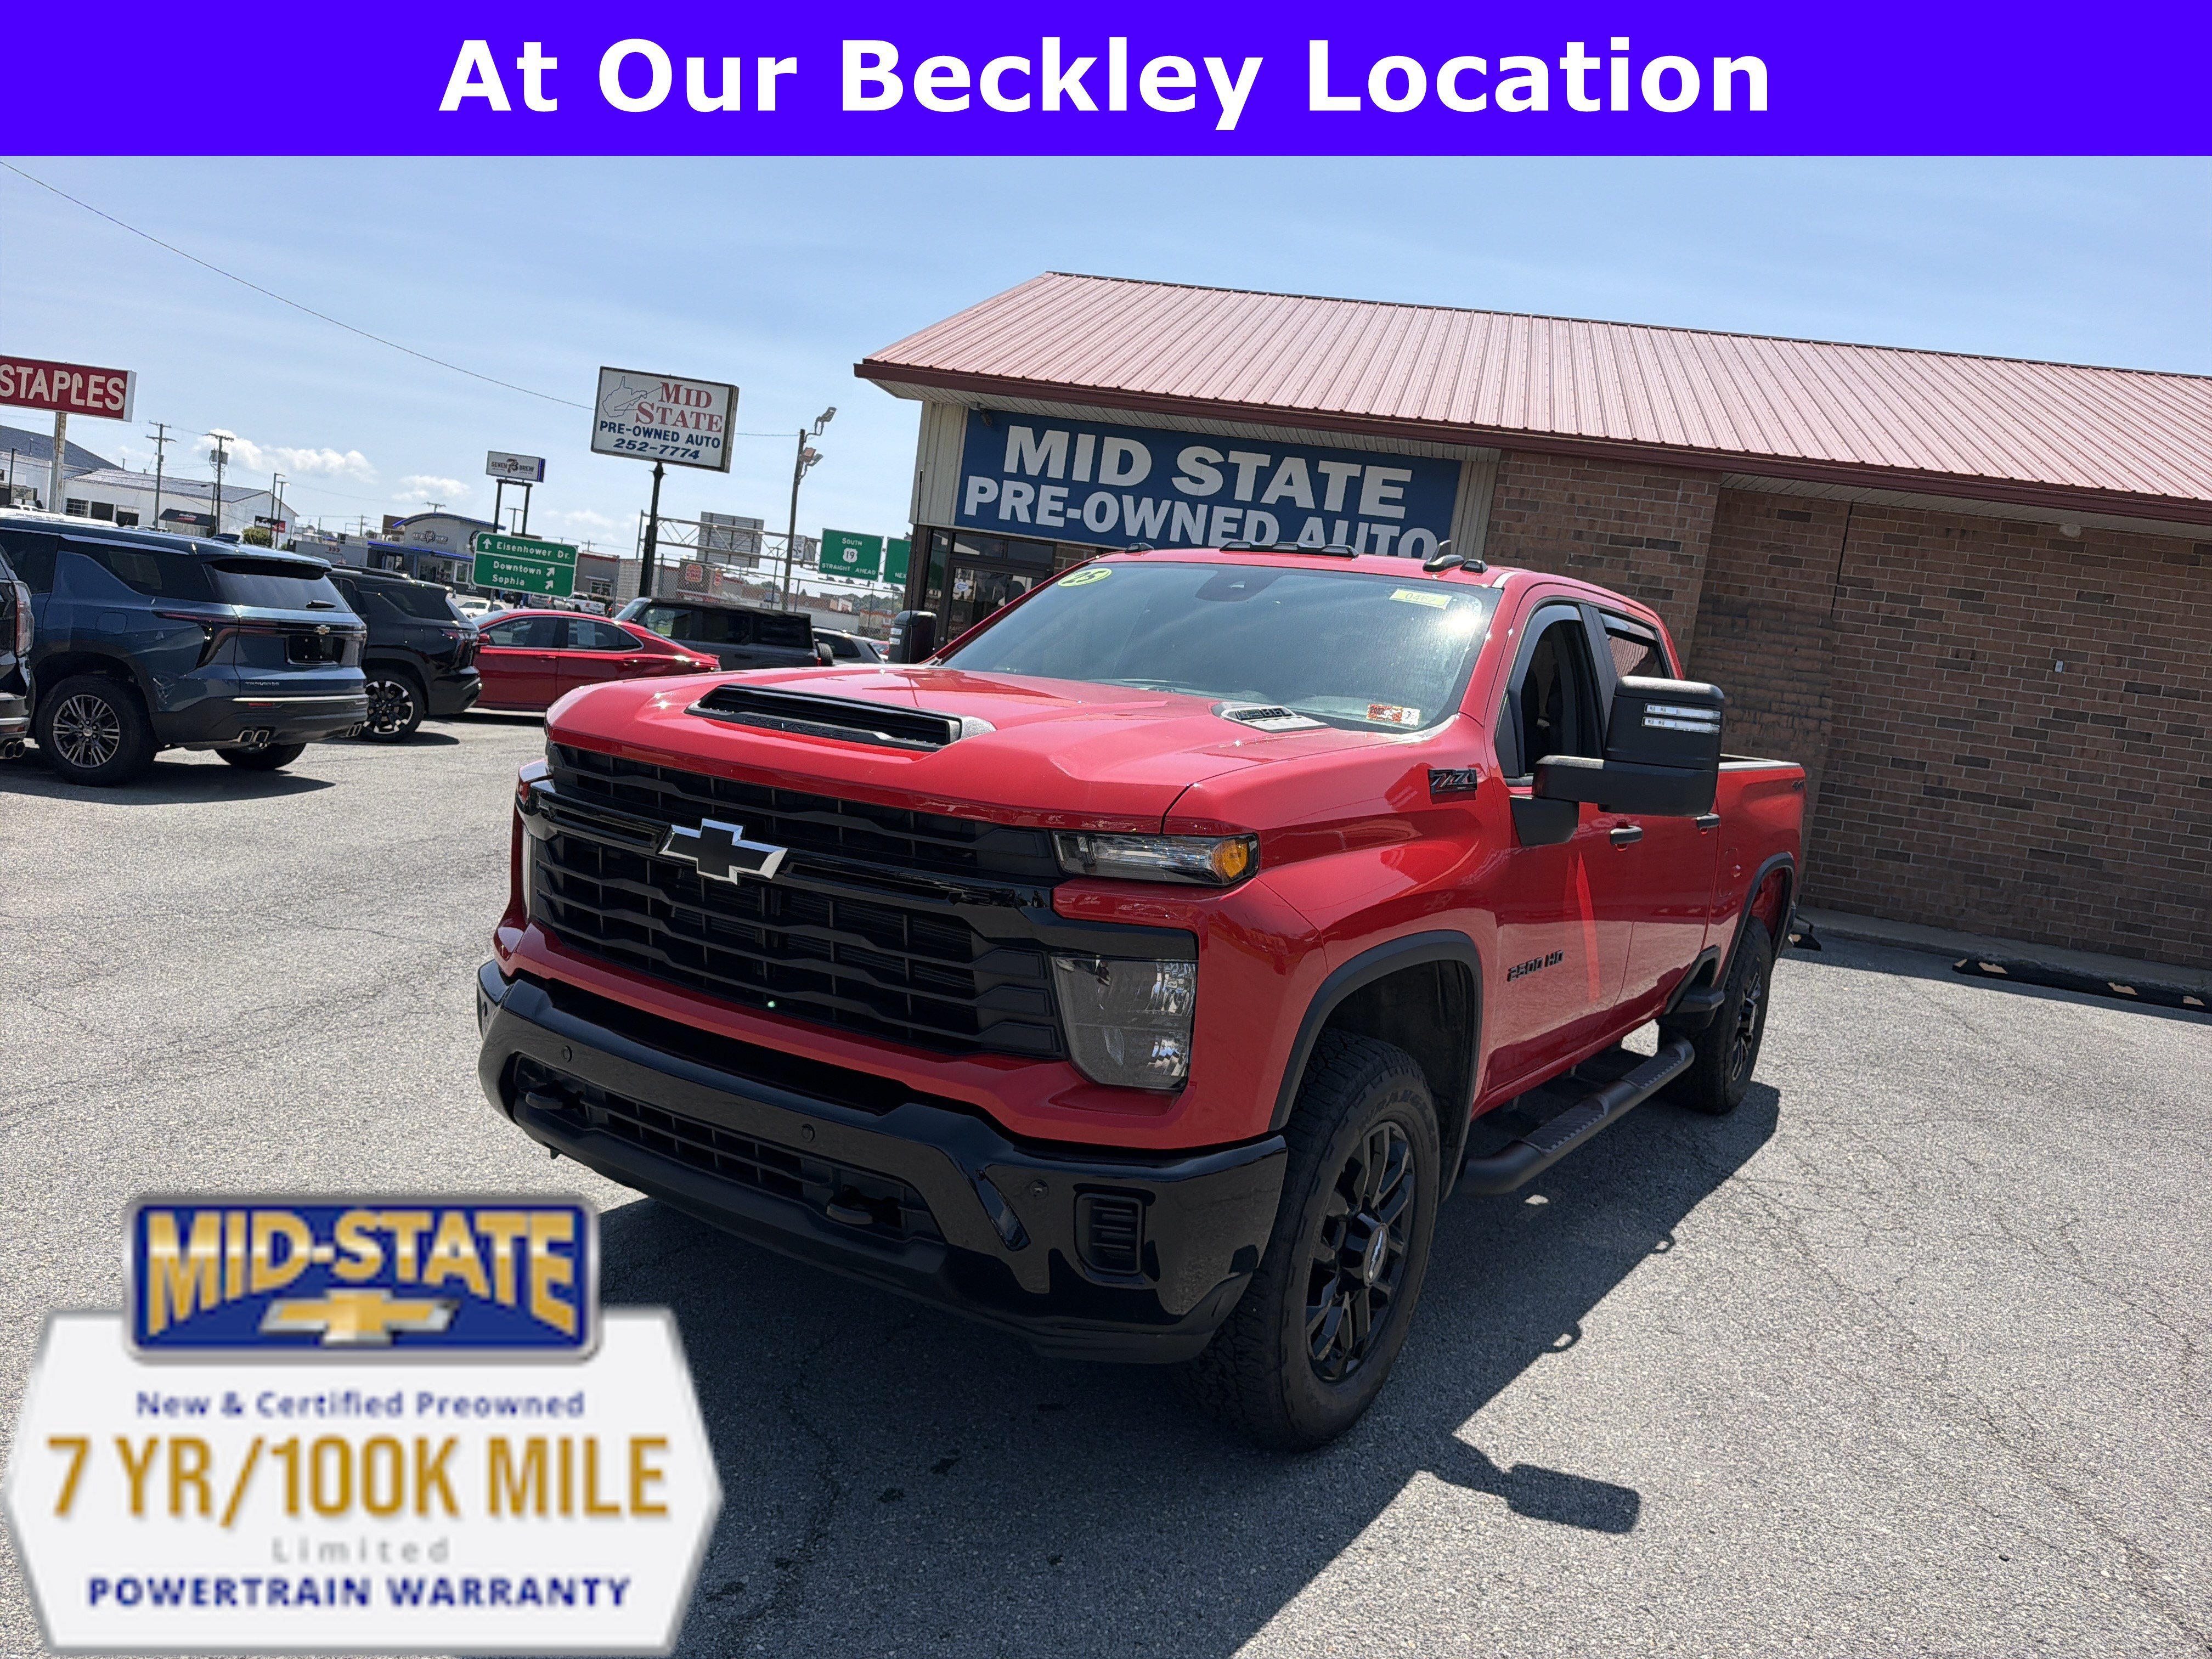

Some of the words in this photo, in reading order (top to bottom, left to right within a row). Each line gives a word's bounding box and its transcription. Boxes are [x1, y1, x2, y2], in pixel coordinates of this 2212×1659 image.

[0, 364, 125, 411] STAPLES
[658, 381, 712, 409] MID
[635, 401, 723, 433] STATE
[599, 420, 680, 442] PRE-OWNED
[685, 433, 720, 449] AUTO
[613, 438, 701, 460] 252-7774
[490, 461, 507, 469] SEVEN
[1003, 425, 1152, 487] MID
[1171, 445, 1413, 519] STATE
[964, 475, 1280, 548] PRE-OWNED
[1296, 516, 1438, 559] AUTO
[496, 541, 552, 557] Eisenhower
[842, 537, 862, 546] SOUTH
[846, 550, 855, 560] 19
[493, 560, 541, 575] Downtown
[822, 562, 850, 572] STRAIGHT
[492, 574, 525, 586] Sophia
[743, 715, 860, 739] CHEVROLET
[1506, 956, 1544, 982] 2500
[1544, 950, 1564, 967] HD
